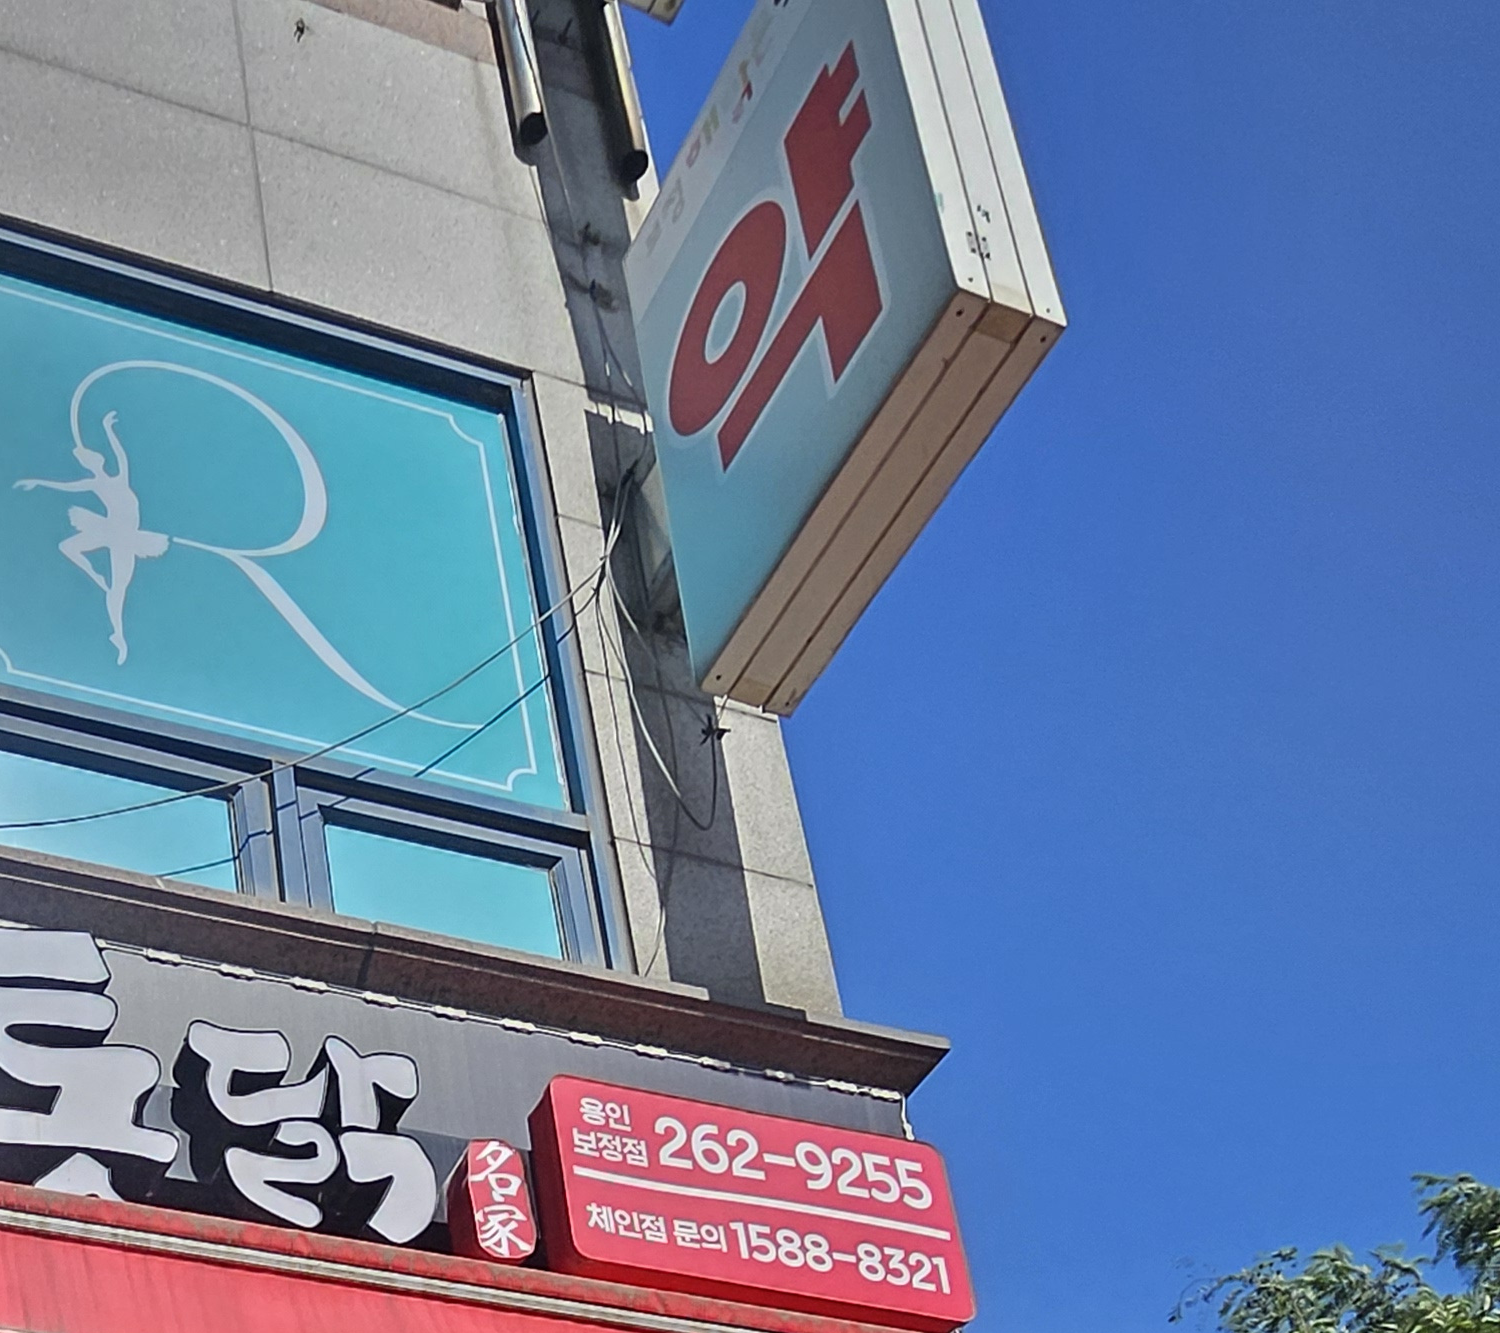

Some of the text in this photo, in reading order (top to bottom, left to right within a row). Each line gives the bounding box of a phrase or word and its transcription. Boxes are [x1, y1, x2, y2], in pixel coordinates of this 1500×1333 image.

[668, 38, 883, 472] 약
[572, 1128, 649, 1168] 보정점
[579, 1096, 632, 1132] 용인
[653, 1116, 934, 1211] 262-9255
[585, 1202, 952, 1296] 체인점 문의 1588-8321
